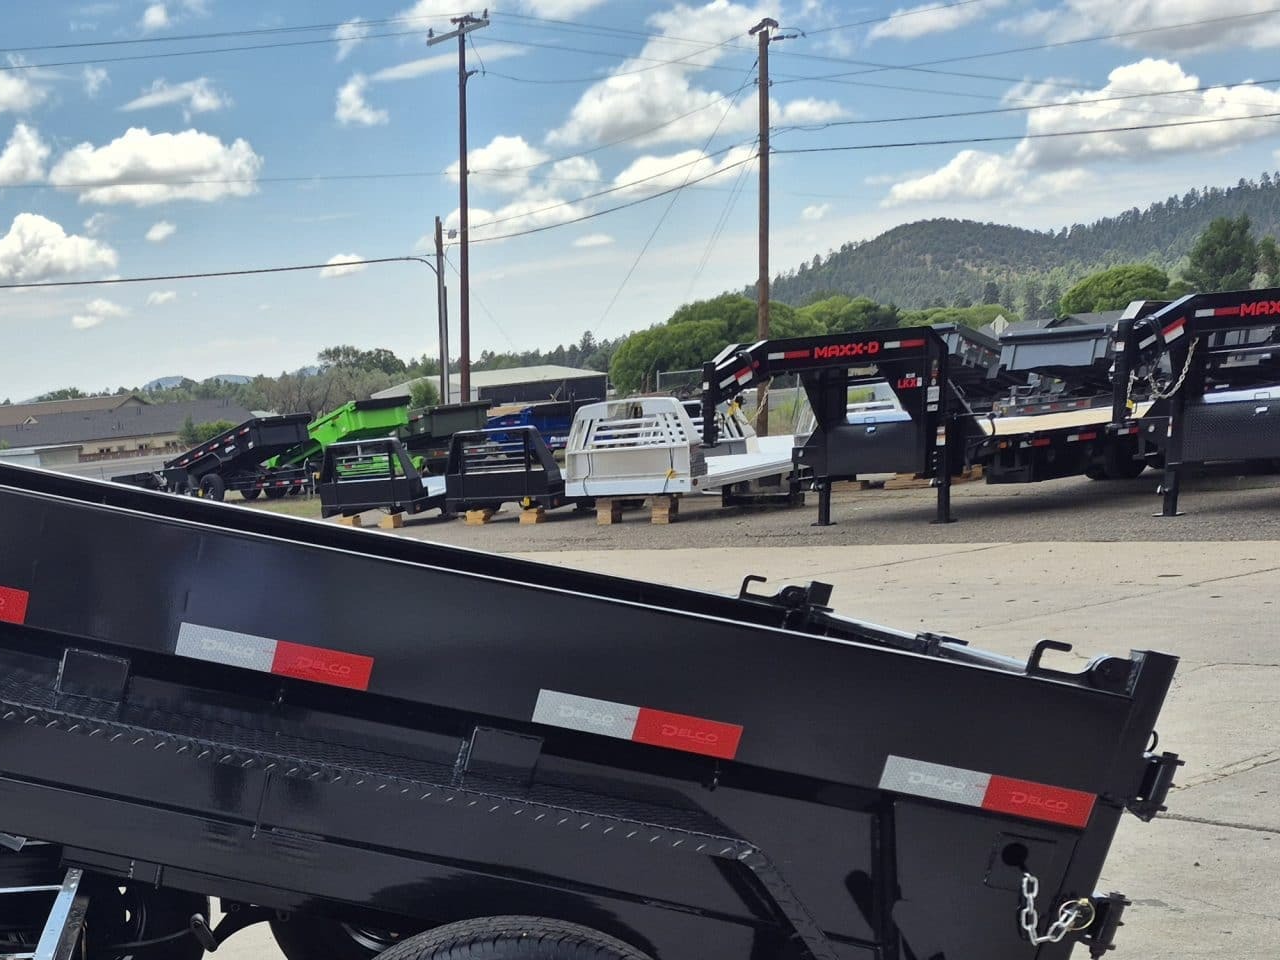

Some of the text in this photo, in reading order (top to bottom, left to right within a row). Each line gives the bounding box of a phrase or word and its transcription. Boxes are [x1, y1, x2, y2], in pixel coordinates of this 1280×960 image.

[814, 341, 879, 359] MAXX-D
[296, 656, 352, 674] DELCO
[662, 724, 719, 743] DELCO
[1011, 791, 1069, 810] DELCO
